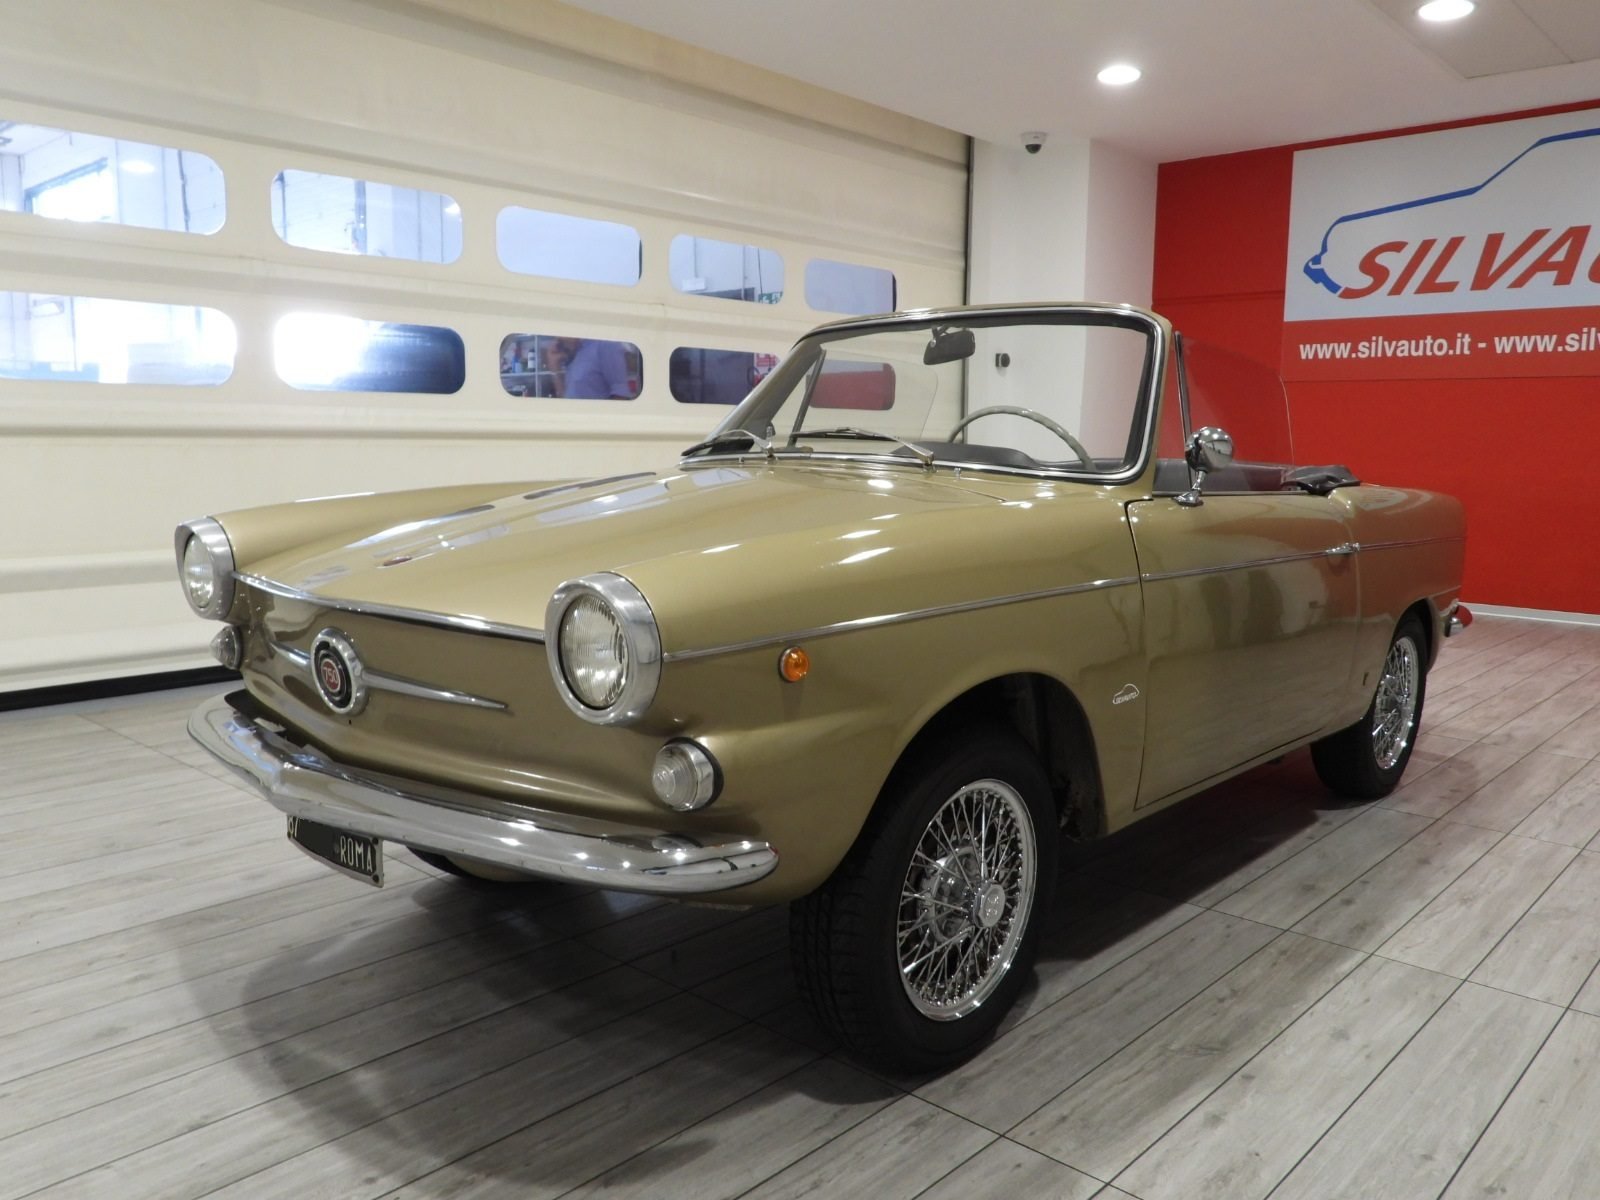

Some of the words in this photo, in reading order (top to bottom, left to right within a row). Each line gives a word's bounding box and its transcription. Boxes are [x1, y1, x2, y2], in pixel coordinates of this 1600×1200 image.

[1300, 333, 1471, 360] www.silvauto.it
[1494, 327, 1600, 354] www.sil
[323, 666, 339, 685] 750
[340, 835, 373, 873] ROMA
